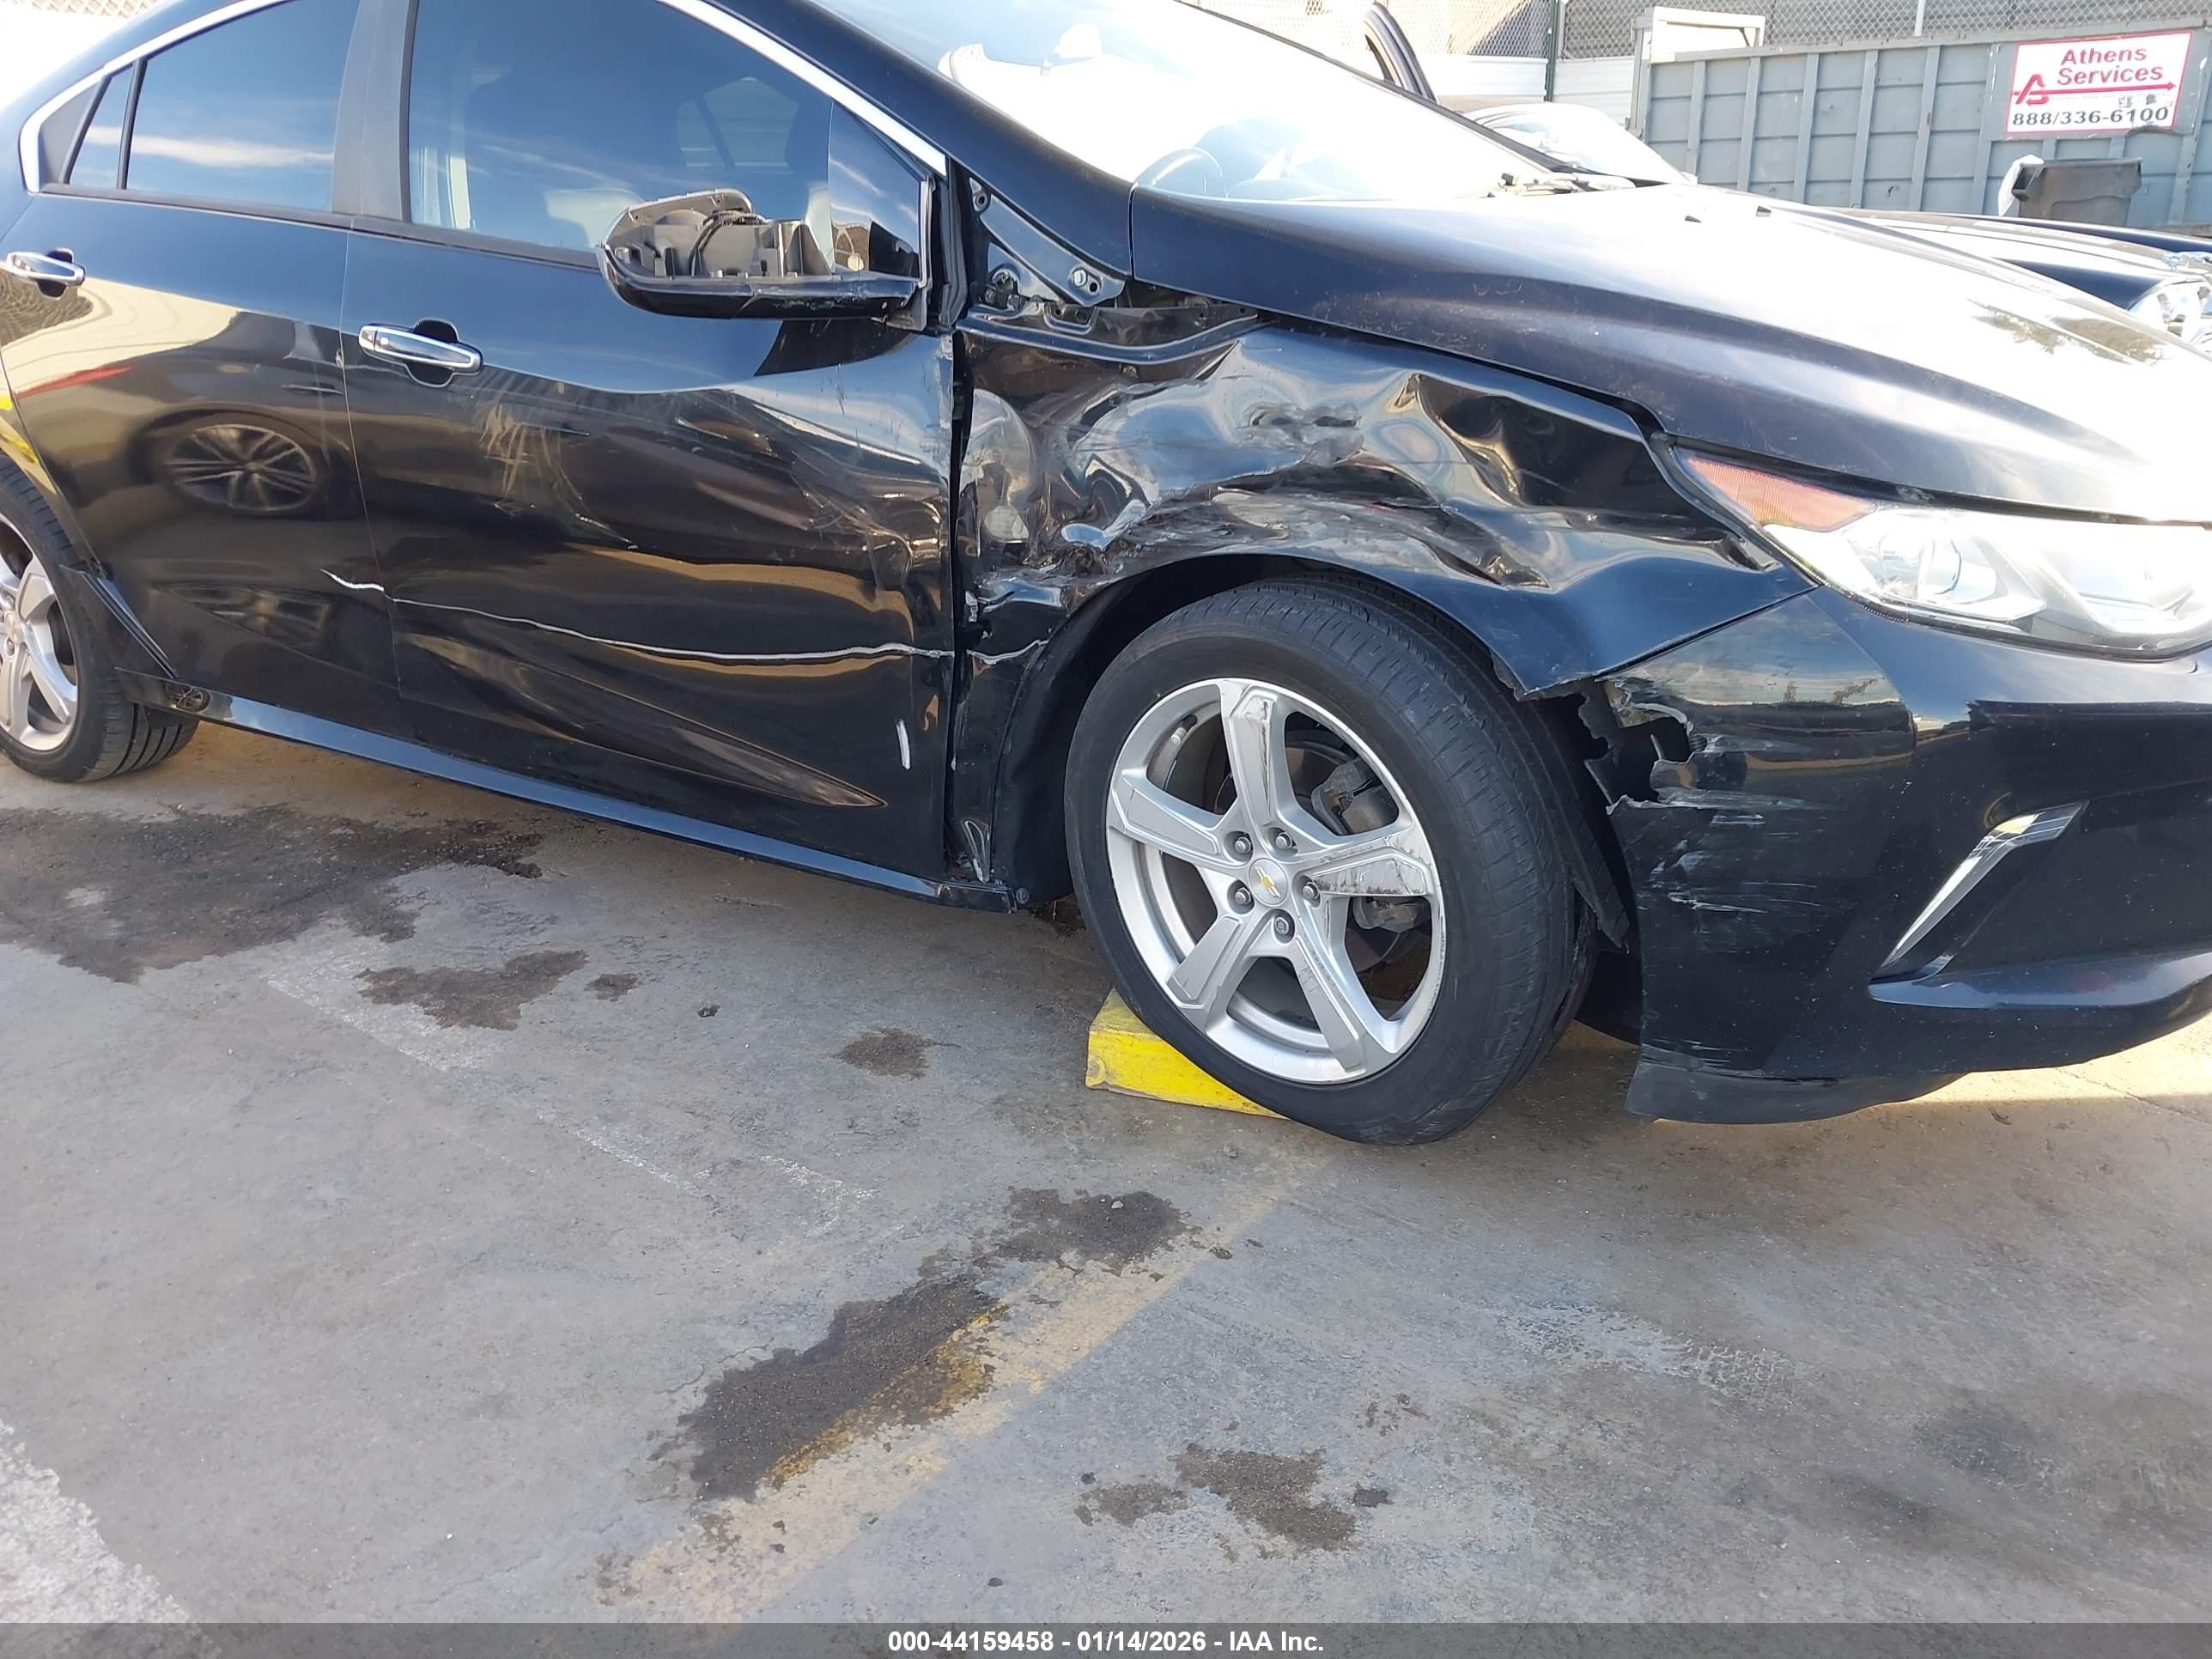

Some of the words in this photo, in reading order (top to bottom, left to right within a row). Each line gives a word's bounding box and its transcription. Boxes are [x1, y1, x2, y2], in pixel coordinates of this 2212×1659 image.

[2060, 47, 2148, 66] Athens
[2057, 64, 2164, 86] Services
[2012, 106, 2169, 126] 888/336-6100
